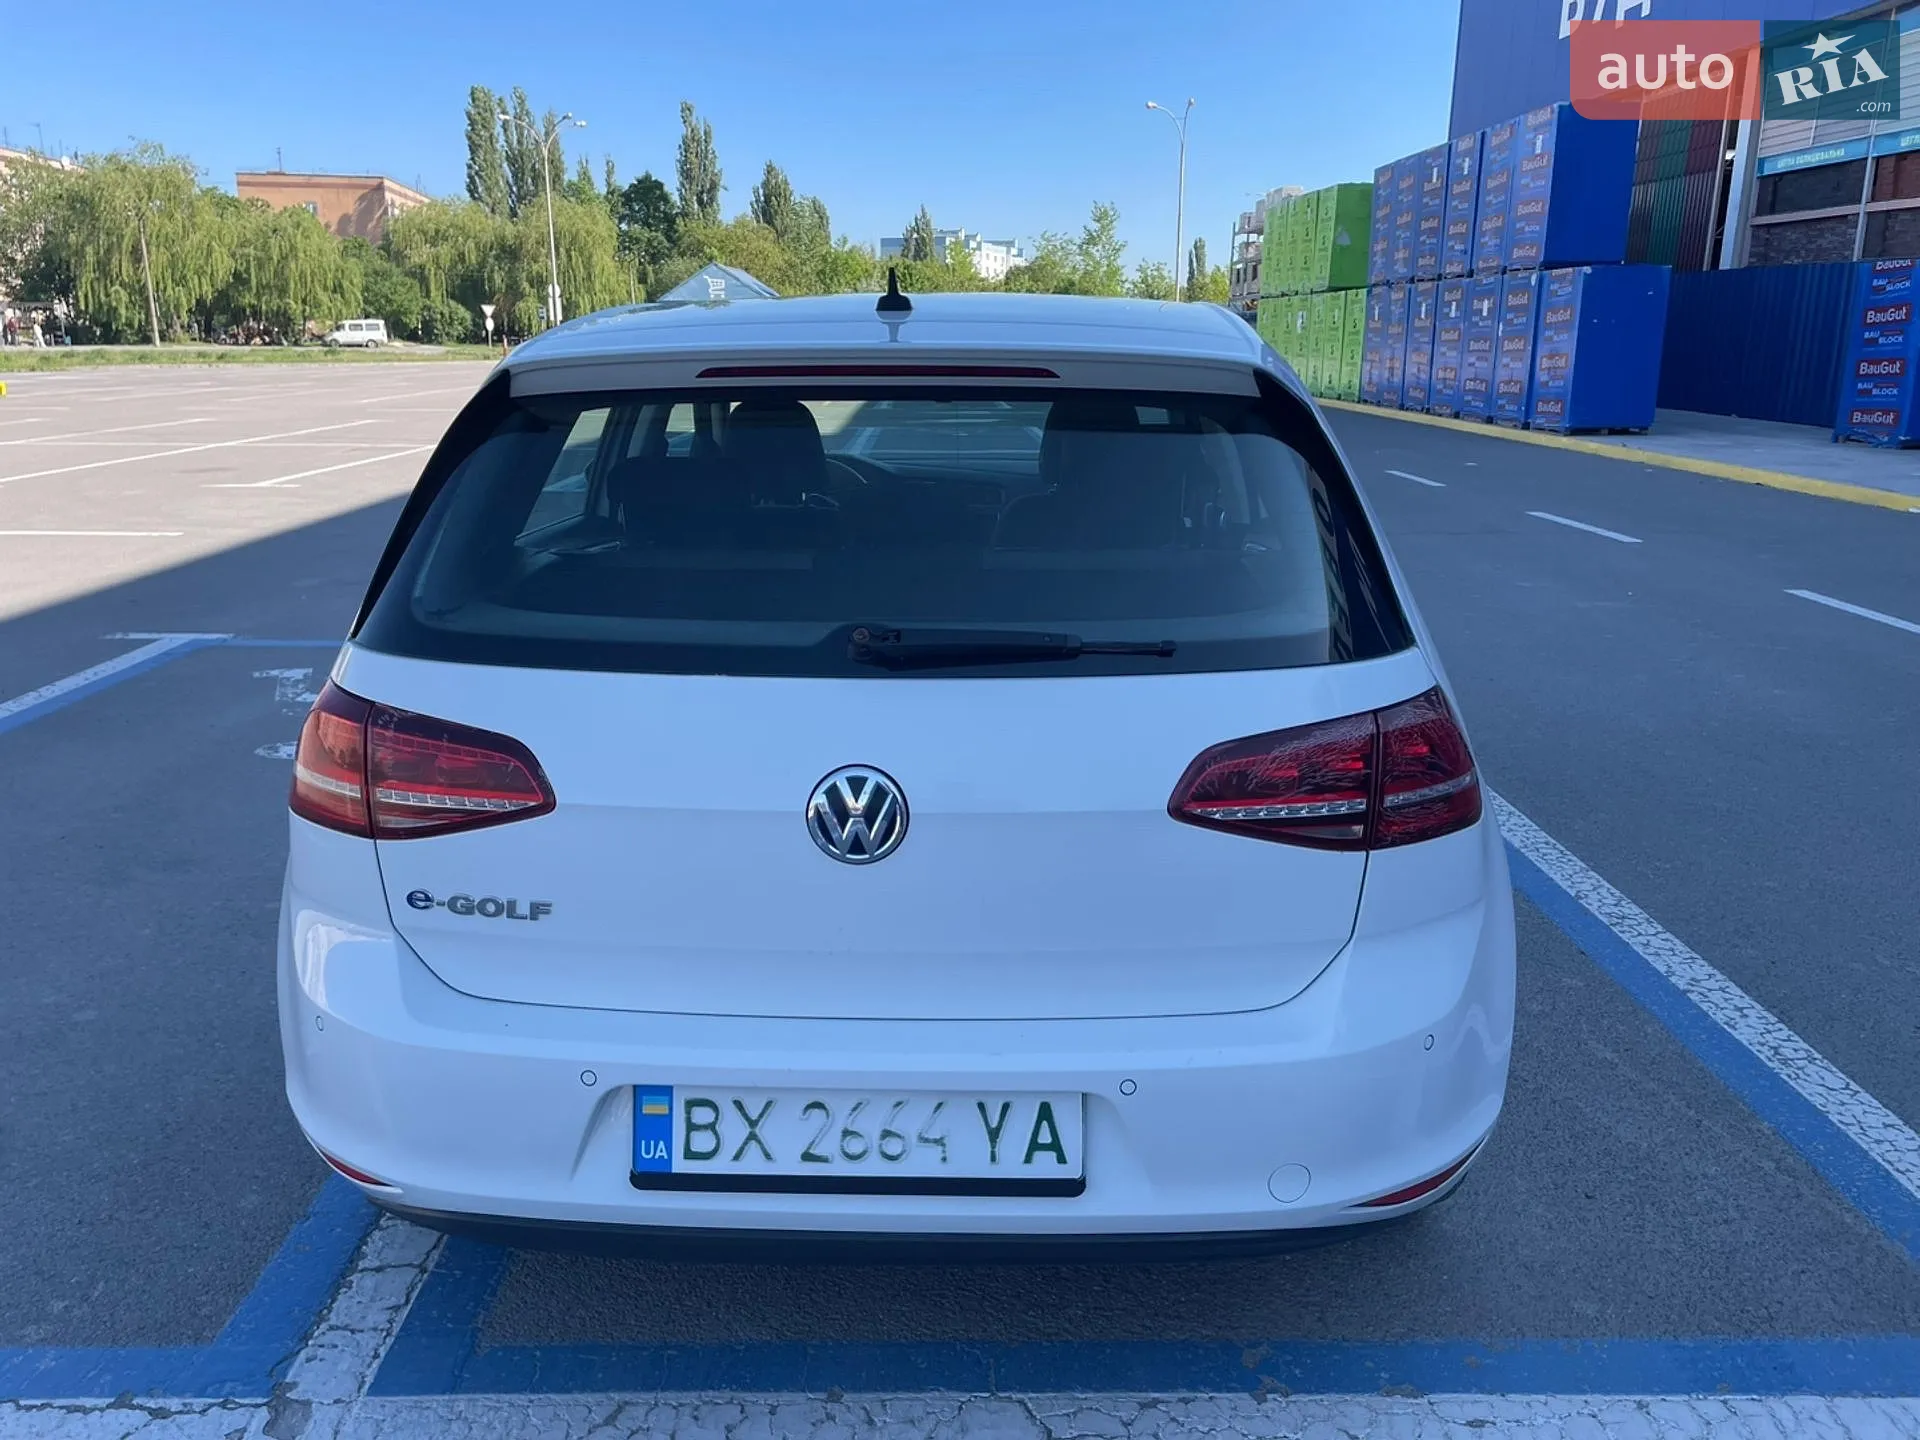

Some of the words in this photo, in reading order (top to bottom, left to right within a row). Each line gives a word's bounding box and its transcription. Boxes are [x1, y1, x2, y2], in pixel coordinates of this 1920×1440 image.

[1866, 306, 1906, 323] BauGut
[1878, 335, 1903, 344] BLOCK
[1859, 361, 1900, 375] BauGut
[1872, 387, 1898, 395] BLOCK
[1852, 411, 1895, 424] BauGut
[406, 888, 553, 922] e-GOLF
[799, 1099, 948, 1164] 2664
[641, 1140, 669, 1160] UA
